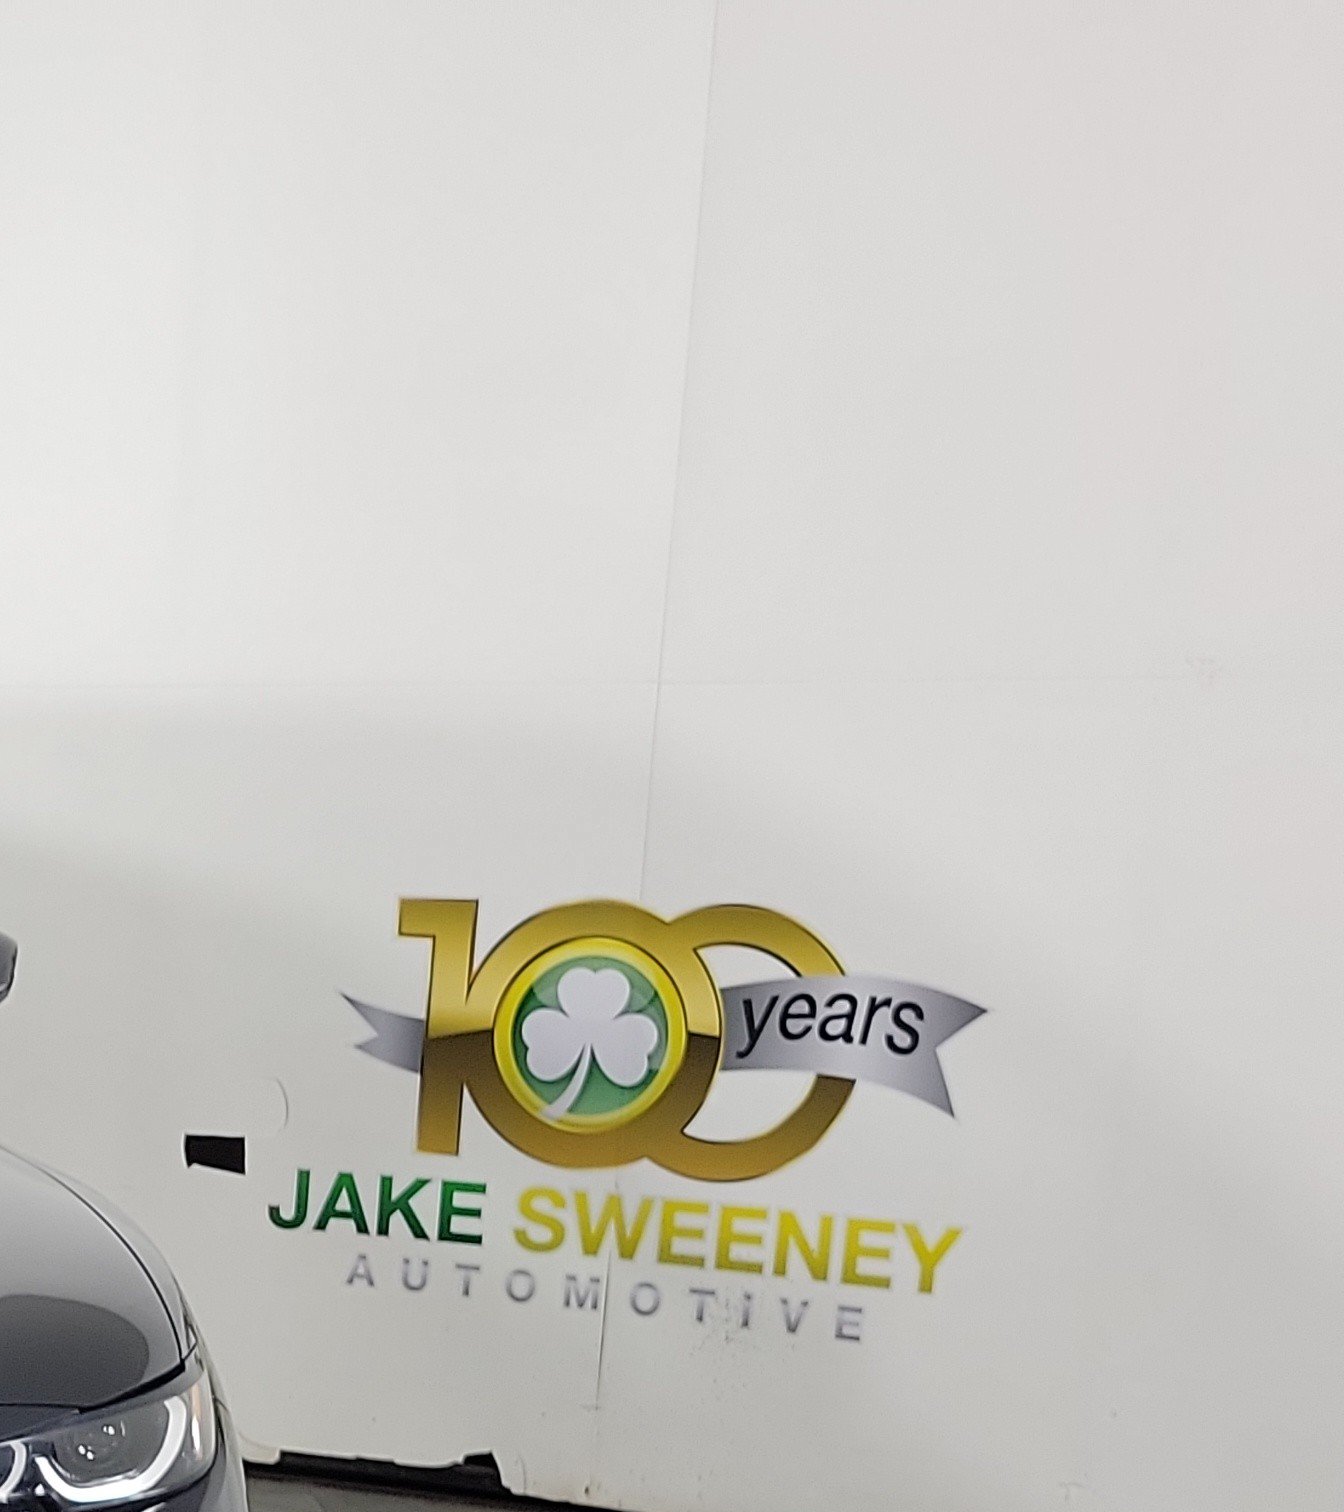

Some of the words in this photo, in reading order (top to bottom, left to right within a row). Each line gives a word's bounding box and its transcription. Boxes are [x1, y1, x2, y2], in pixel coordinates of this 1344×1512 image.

[398, 898, 856, 1183] 100
[735, 988, 926, 1058] years
[267, 1168, 488, 1245] JAKE
[513, 1187, 964, 1296] SWEENEY
[345, 1254, 865, 1343] AUTOMOTIVE
